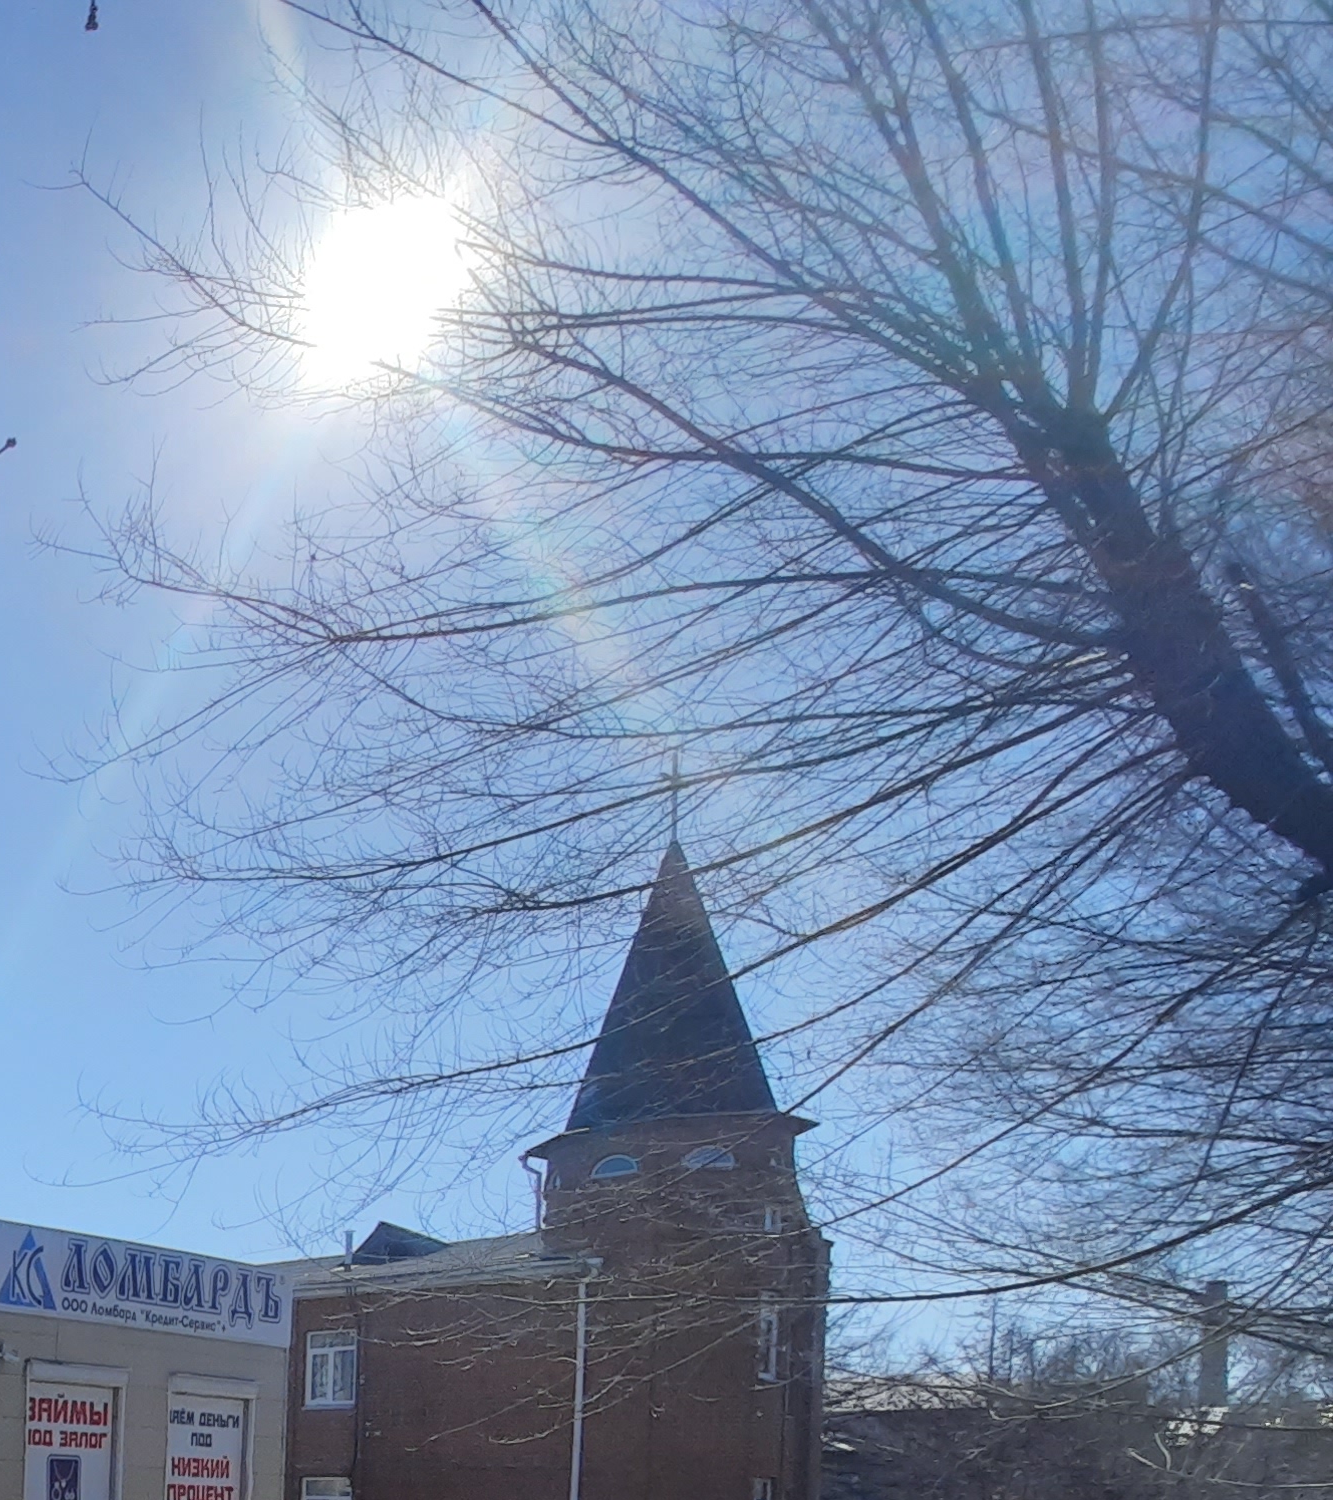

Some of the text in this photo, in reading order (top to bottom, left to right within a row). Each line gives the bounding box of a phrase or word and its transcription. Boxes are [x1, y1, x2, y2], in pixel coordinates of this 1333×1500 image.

[61, 1238, 281, 1329] ЛОМБАРДЪ
[62, 1297, 87, 1312] ООО
[91, 1303, 137, 1323] Ломбард
[199, 1412, 239, 1429] ДЕНЬГИ
[59, 1430, 107, 1449] ЗАЛОГ
[191, 1432, 212, 1447] ПОД
[171, 1455, 230, 1479] НИЗКИЙ
